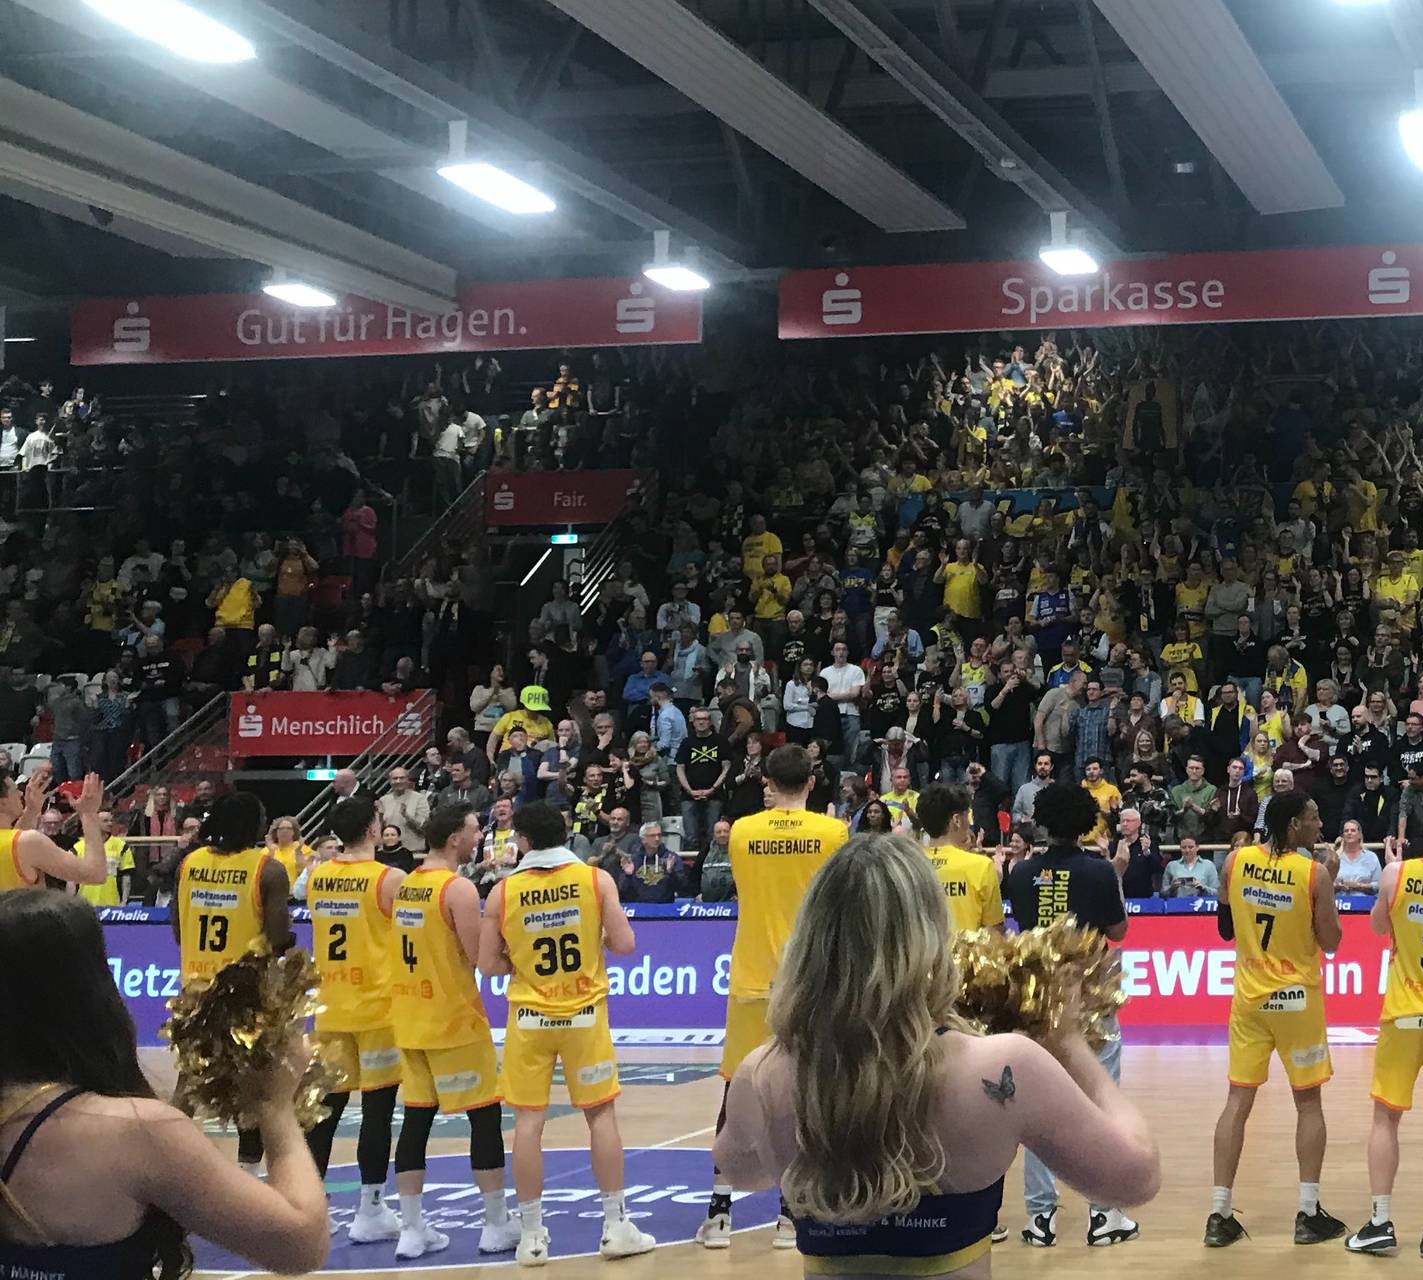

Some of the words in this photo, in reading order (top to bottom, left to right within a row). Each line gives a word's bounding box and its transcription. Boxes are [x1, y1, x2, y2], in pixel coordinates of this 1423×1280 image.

[1001, 273, 1225, 323] Sparkasse
[236, 308, 304, 345] Gut
[317, 304, 374, 344] für
[386, 303, 528, 350] Hagen.
[553, 491, 588, 507] Fair.
[271, 714, 384, 736] Menschlich
[768, 819, 804, 827] PHOENIX
[748, 839, 821, 855] NEUGEBAUER
[312, 876, 369, 893] NAWROCKI
[1242, 863, 1296, 886] McCALL
[520, 883, 580, 906] KRAUSE
[1242, 886, 1293, 904] platzmann
[110, 909, 150, 922] Thalia
[523, 908, 580, 925] platzmann
[691, 905, 732, 917] Thalia
[1037, 885, 1054, 928] HAGE
[198, 914, 229, 953] 13
[328, 923, 347, 961] 2
[1255, 913, 1276, 952] 7
[402, 934, 418, 973] 4
[532, 933, 582, 977] 36
[107, 957, 181, 998] Jetz
[1121, 951, 1237, 996] EWE
[895, 1216, 948, 1228] MAHNKE
